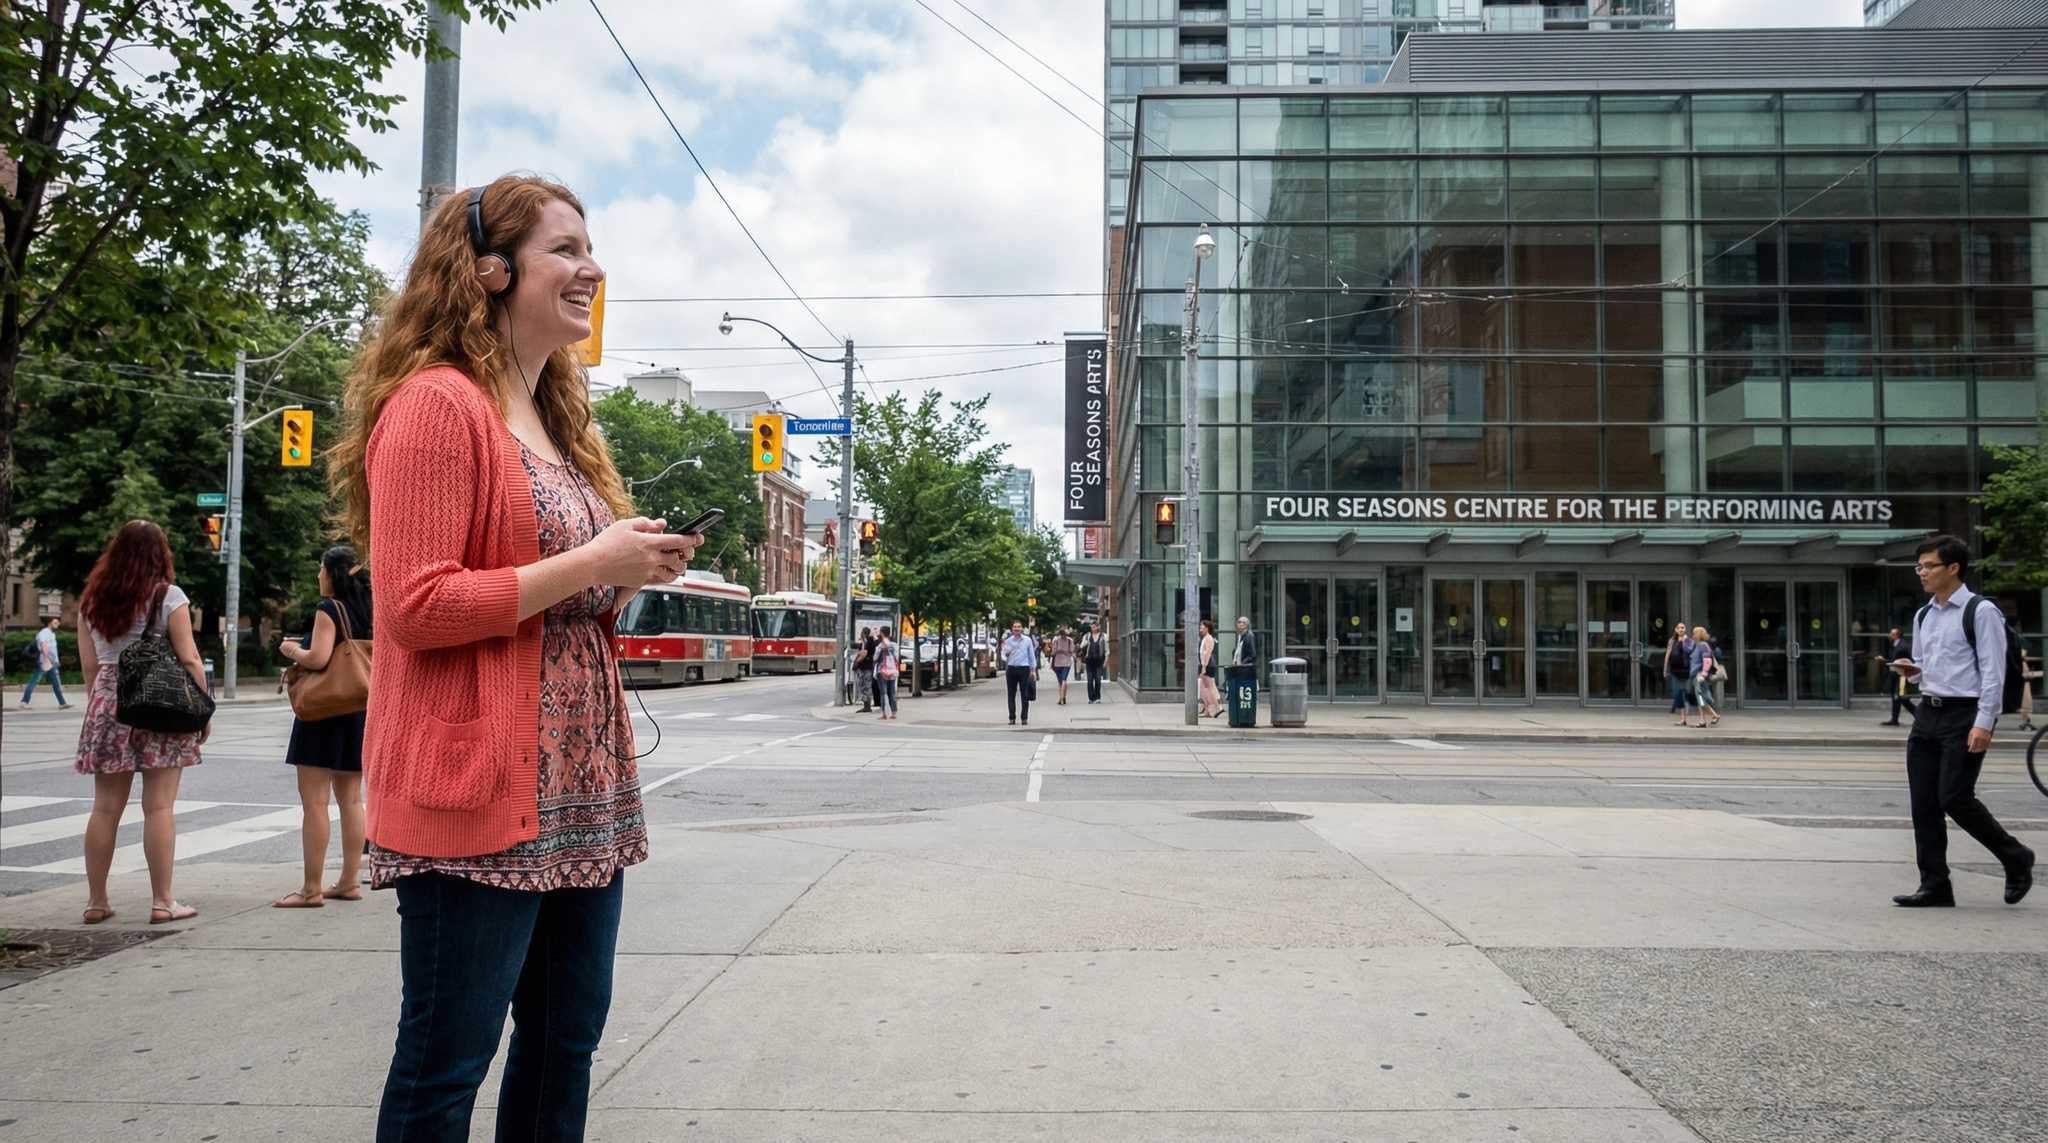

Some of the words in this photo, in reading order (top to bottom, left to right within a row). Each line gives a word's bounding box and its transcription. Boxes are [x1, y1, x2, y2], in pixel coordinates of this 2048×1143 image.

[1086, 348, 1102, 394] ARTS
[1086, 399, 1101, 485] SEASONS
[1070, 461, 1085, 510] FOUR
[1266, 497, 1329, 517] FOUR
[1337, 497, 1447, 518] SEASONS
[1454, 498, 1549, 518] CENTRE
[1556, 498, 1603, 519] FOR
[1609, 499, 1657, 519] THE
[1665, 499, 1823, 520] PERFORMING
[1831, 500, 1893, 520] ARTS
